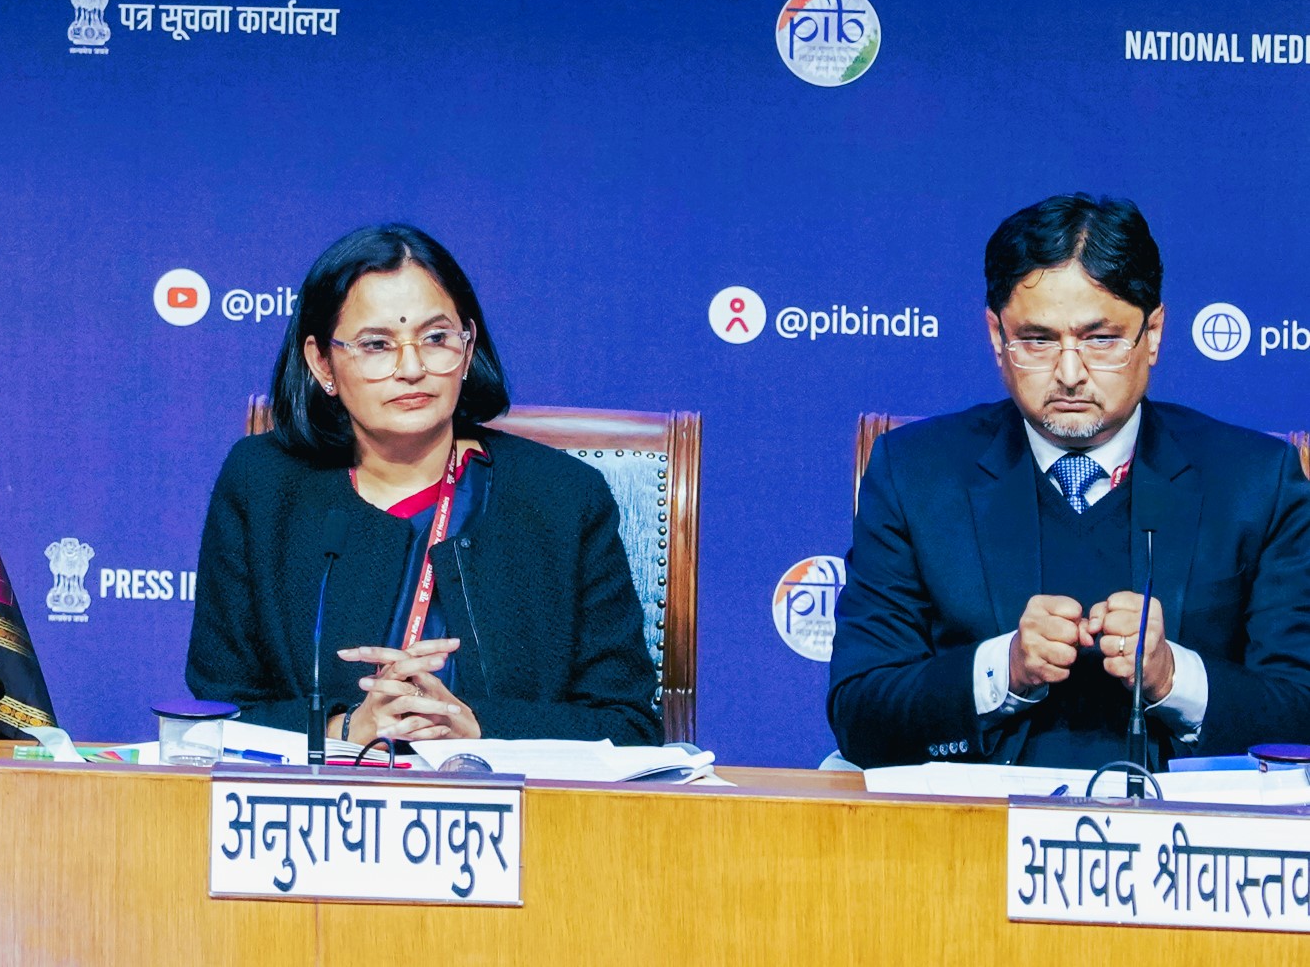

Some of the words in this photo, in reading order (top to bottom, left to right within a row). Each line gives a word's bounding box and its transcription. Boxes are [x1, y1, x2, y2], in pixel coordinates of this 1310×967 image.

[118, 3, 156, 31] पत्र
[158, 4, 233, 41] सूचना
[236, 0, 341, 36] कार्यालय
[1125, 30, 1245, 63] NATIONAL
[775, 304, 939, 341] @pibindia
[1260, 319, 1310, 357] pib
[99, 568, 174, 601] PRESS
[221, 791, 387, 893] अनुराधा
[400, 800, 514, 899] ठाकुर
[1018, 815, 1141, 917] अरविंद
